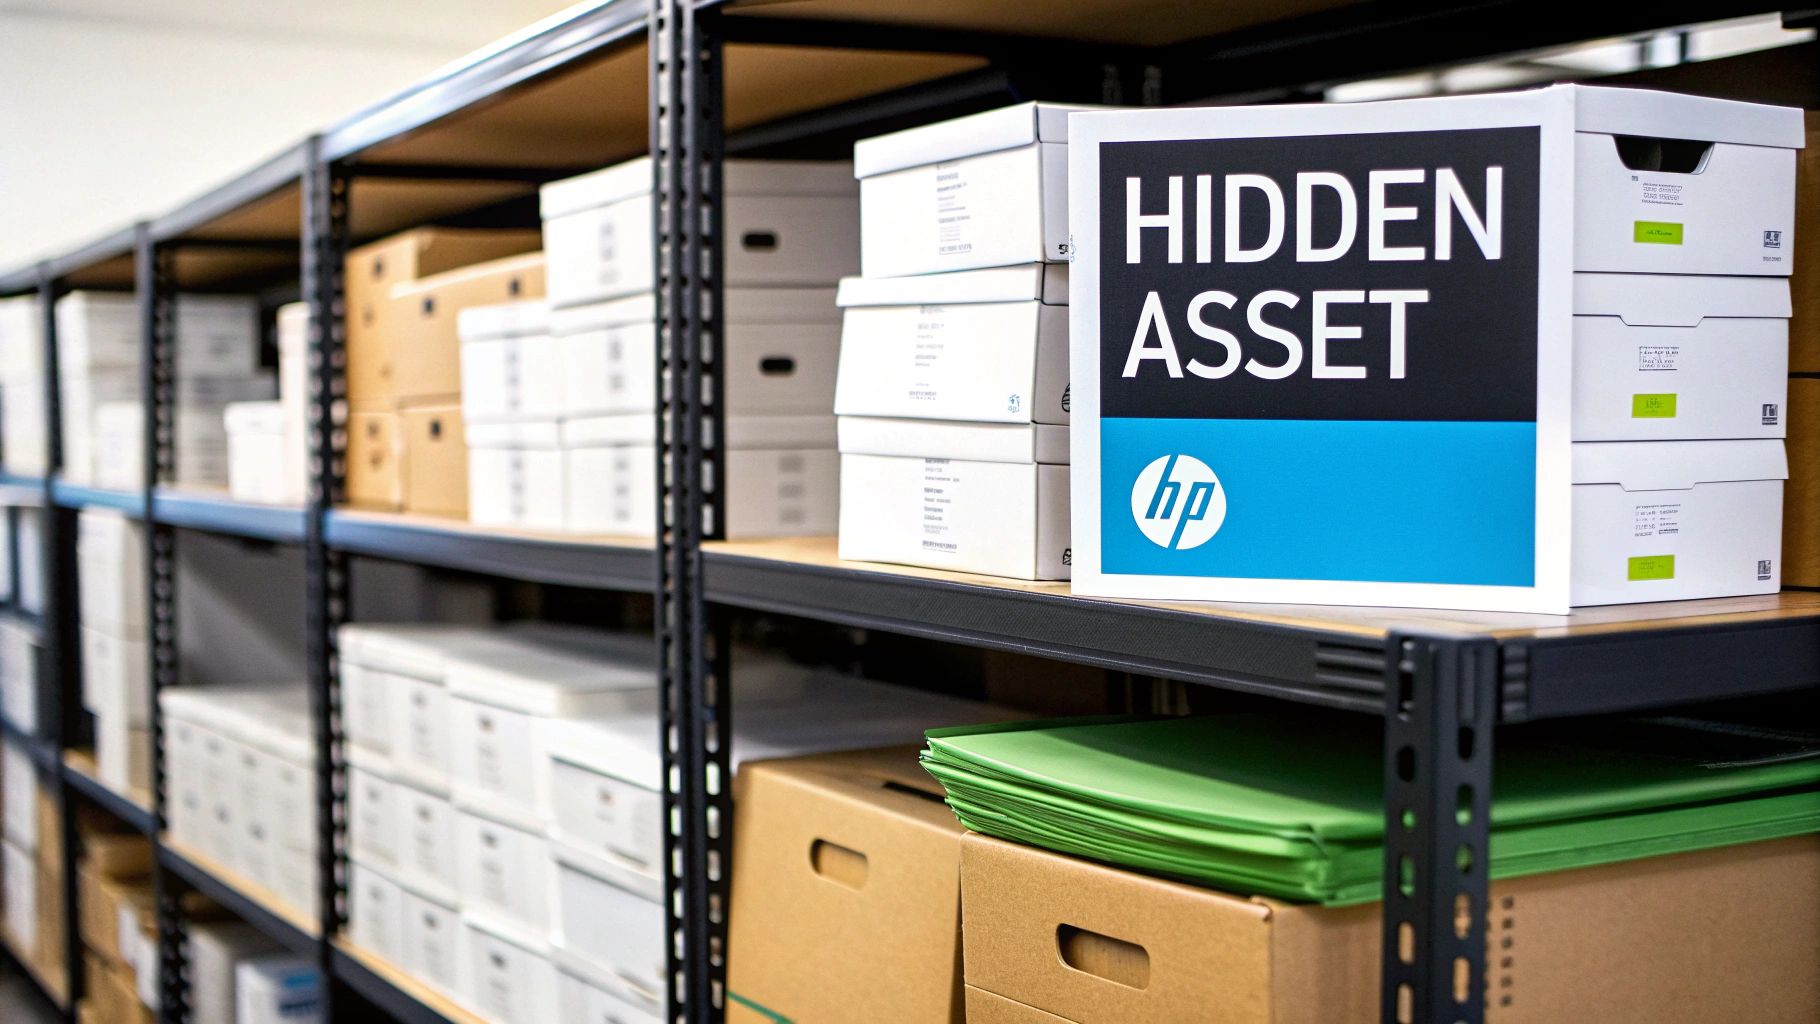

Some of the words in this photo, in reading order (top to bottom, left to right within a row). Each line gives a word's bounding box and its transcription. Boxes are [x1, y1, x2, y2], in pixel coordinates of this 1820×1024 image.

[1125, 165, 1503, 264] HIDDEN
[1121, 289, 1430, 380] ASSET
[1140, 454, 1217, 549] hp
